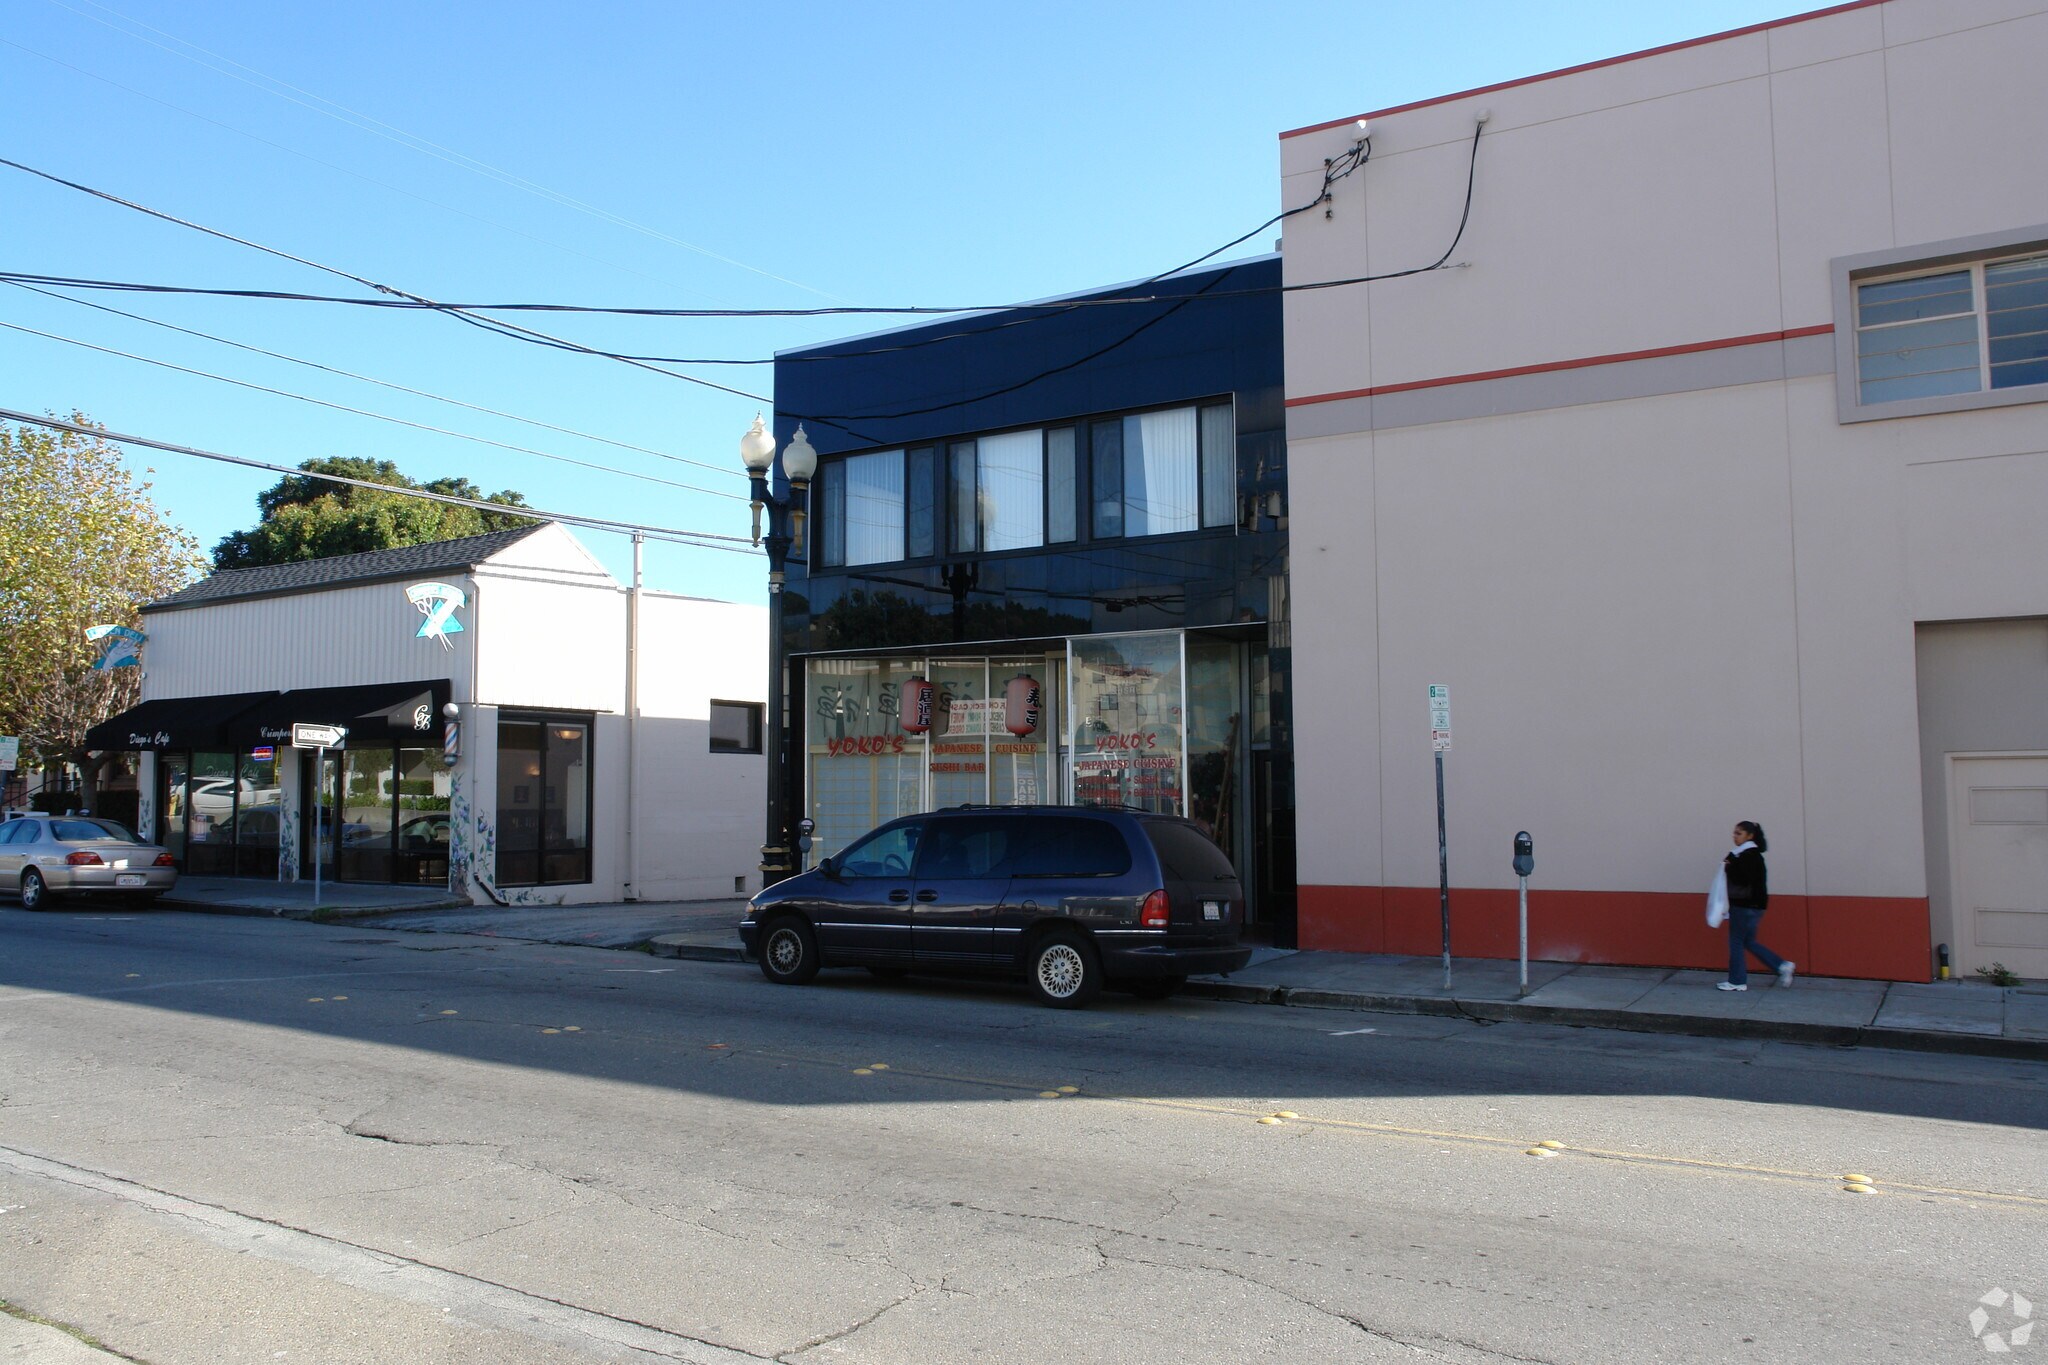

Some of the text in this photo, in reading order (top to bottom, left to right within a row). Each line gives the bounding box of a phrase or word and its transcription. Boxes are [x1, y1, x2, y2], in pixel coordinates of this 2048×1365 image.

[129, 731, 170, 747] Diego's Cafe
[301, 730, 316, 739] ONE
[828, 735, 906, 757] YOKO'S
[932, 743, 1037, 753] JAPANESE CUISINE
[1096, 733, 1156, 753] YOKO'S
[929, 763, 986, 772] SUSHI BAR
[1079, 758, 1176, 770] JAPANESE CUISINE
